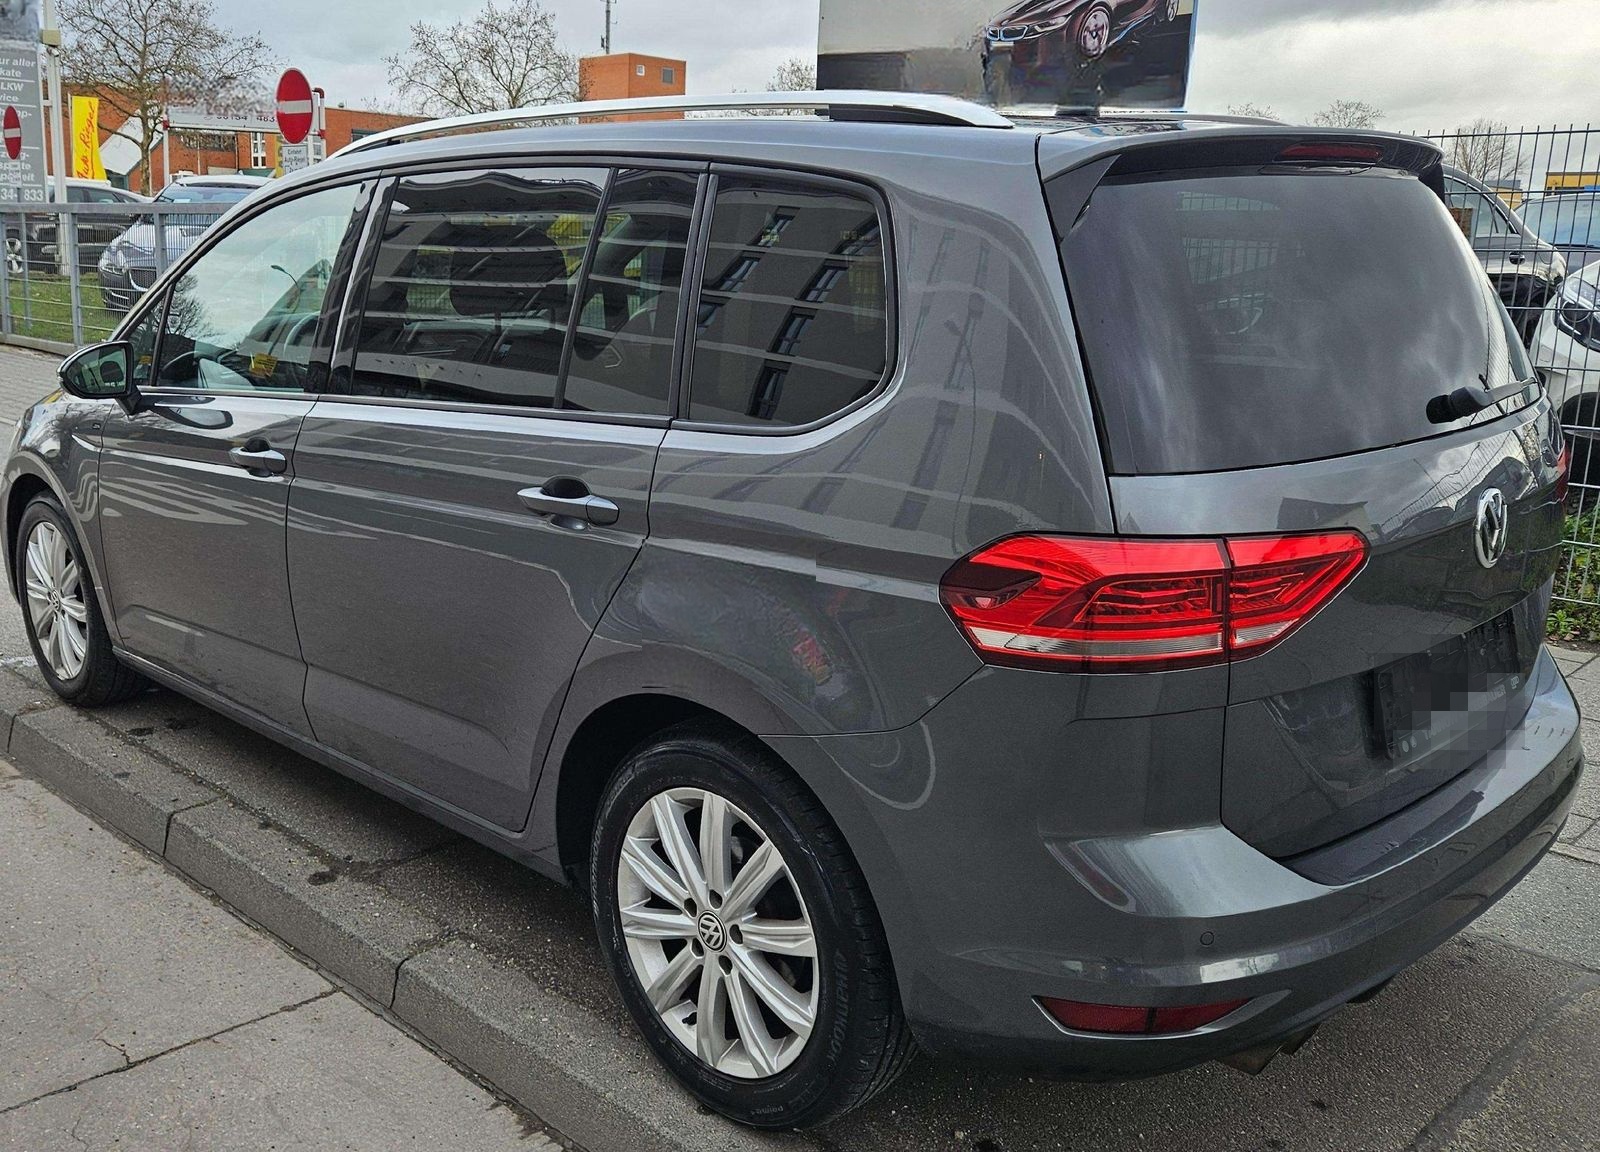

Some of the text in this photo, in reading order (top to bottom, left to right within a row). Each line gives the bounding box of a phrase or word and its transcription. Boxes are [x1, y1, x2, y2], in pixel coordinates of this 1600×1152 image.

[12, 57, 36, 67] aller
[0, 82, 24, 91] LKW
[24, 189, 44, 201] 833
